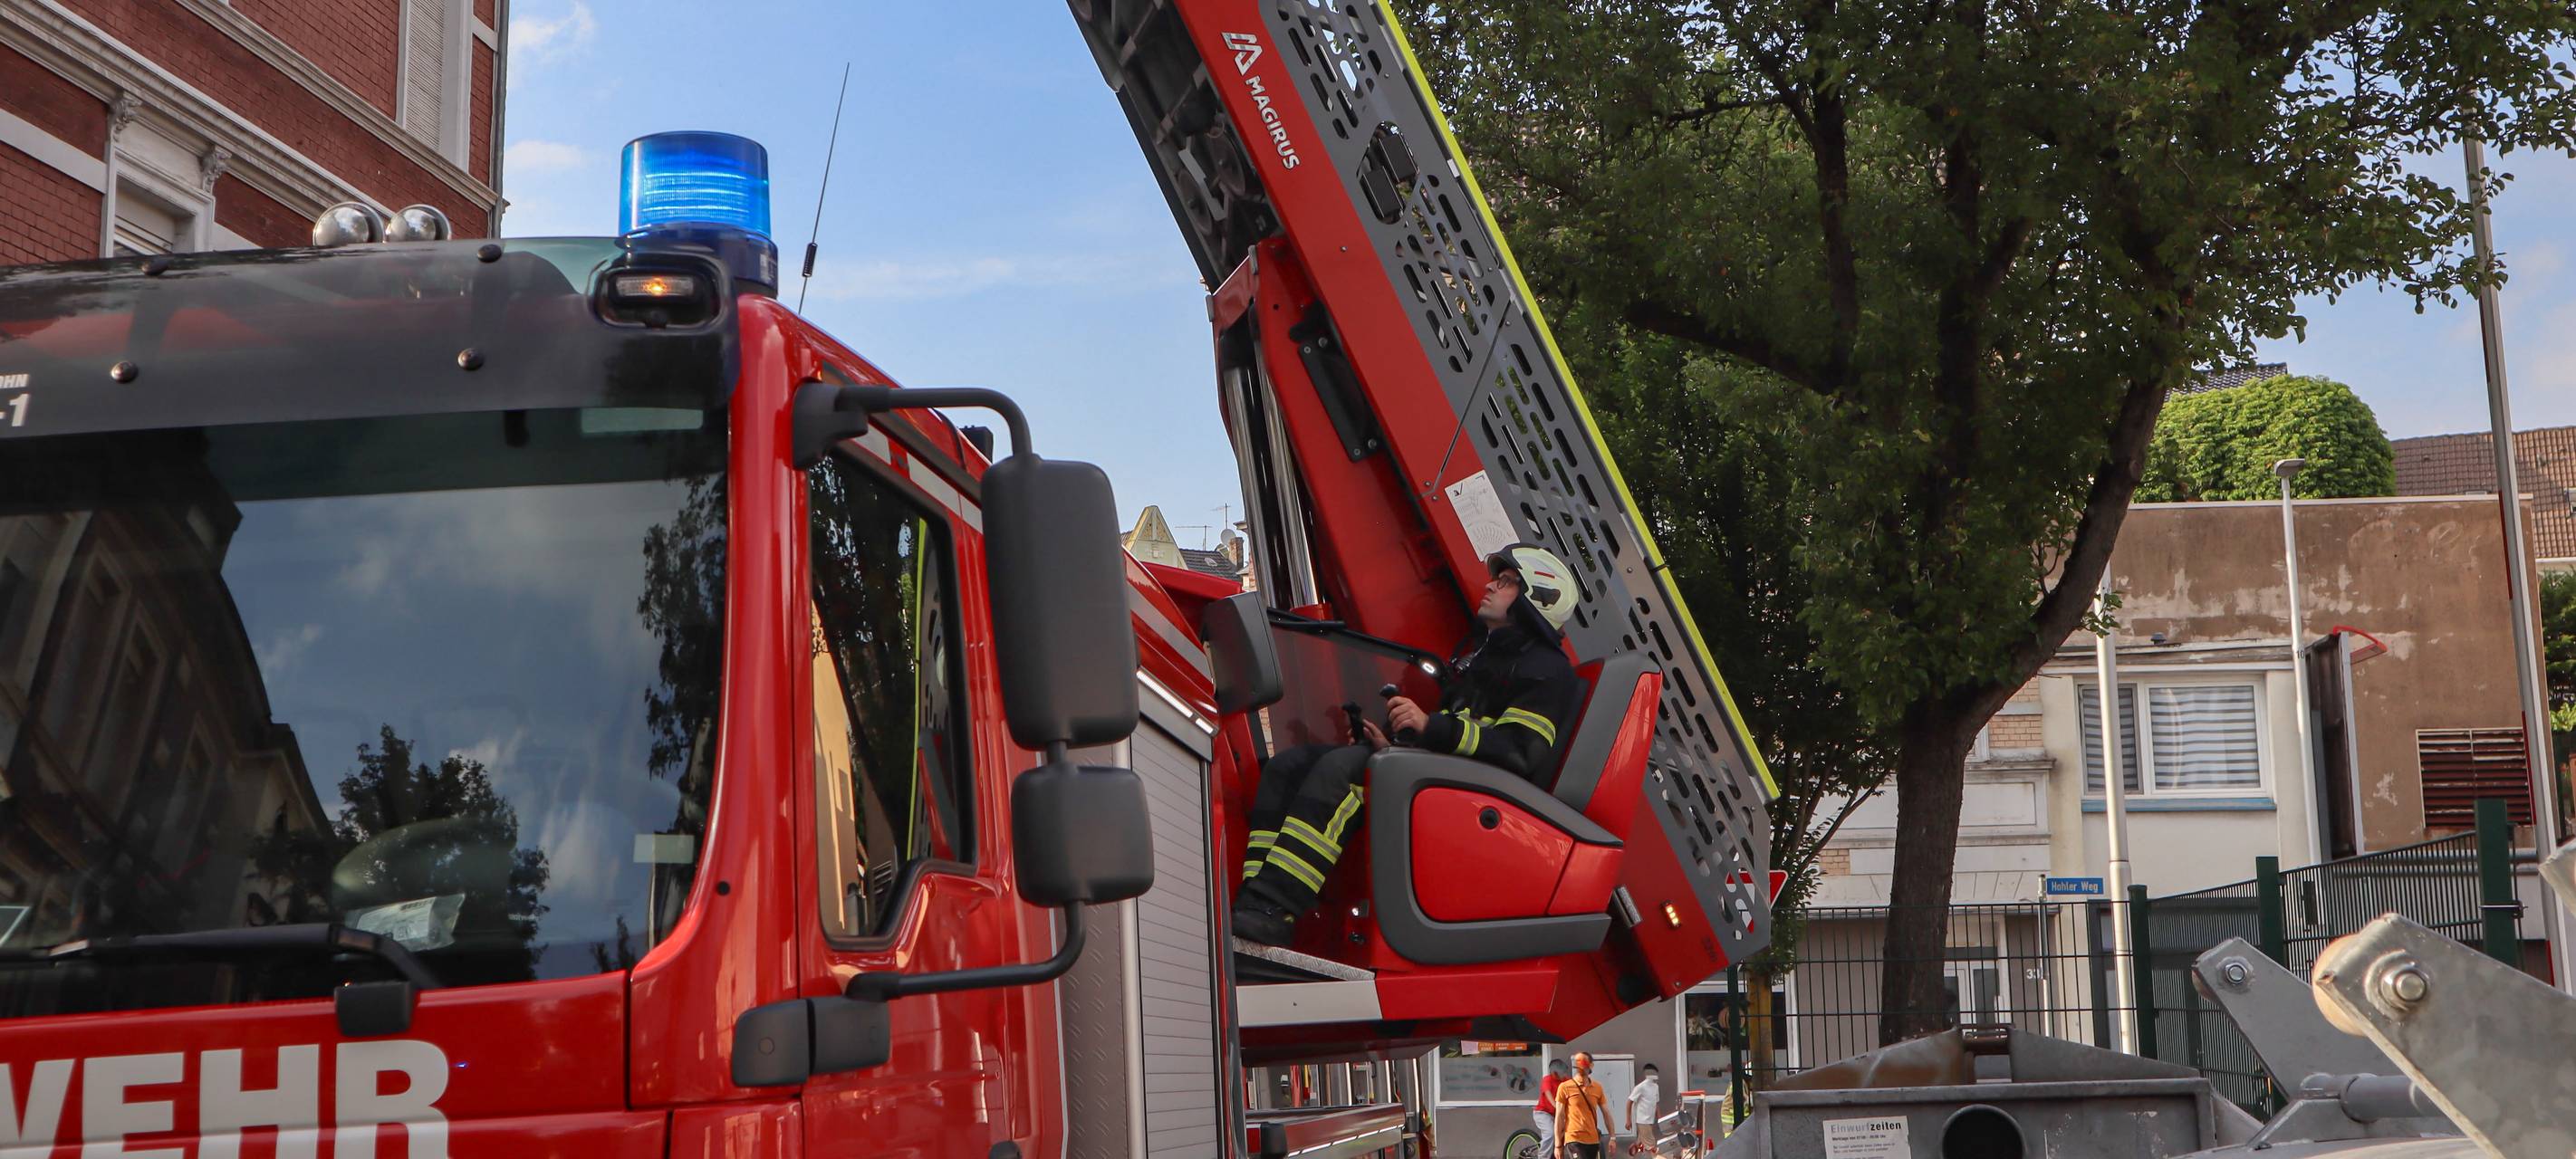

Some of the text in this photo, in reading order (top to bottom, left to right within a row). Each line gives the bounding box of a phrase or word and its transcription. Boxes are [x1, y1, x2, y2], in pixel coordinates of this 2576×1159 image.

[1245, 75, 1300, 169] MAGIRUS
[2051, 881, 2099, 894] Hohler Weg
[1831, 1121, 1901, 1133] Einwurfzeiten
